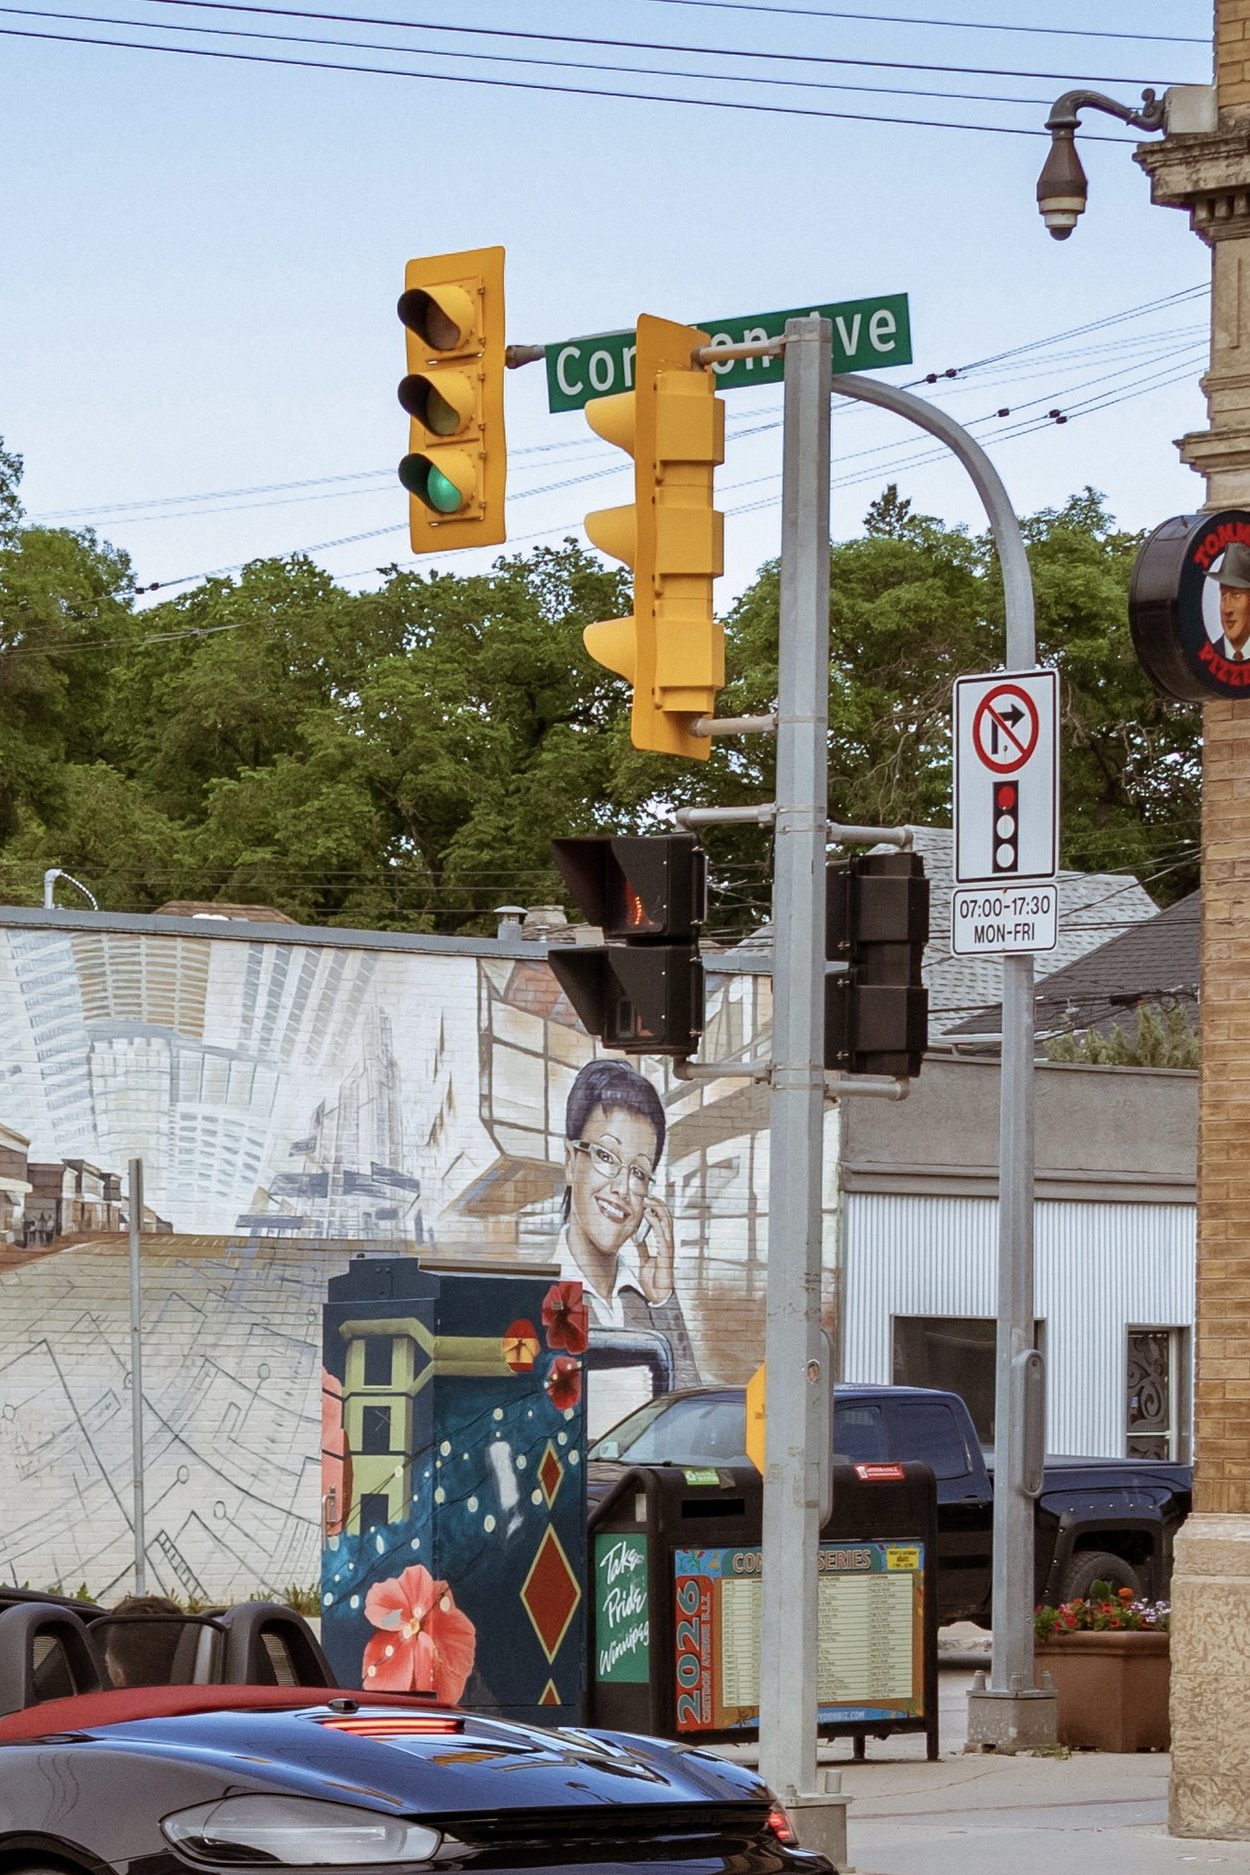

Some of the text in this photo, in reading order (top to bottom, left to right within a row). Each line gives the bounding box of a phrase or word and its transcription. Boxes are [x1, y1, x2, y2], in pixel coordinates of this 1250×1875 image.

[556, 325, 771, 396] Coron
[960, 895, 1050, 919] 07:00-17:30
[974, 922, 1035, 944] MON-FRI
[600, 1541, 636, 1584] Take
[817, 1549, 871, 1571] SERIES
[603, 1584, 647, 1628] Pride
[676, 1580, 700, 1724] 2026
